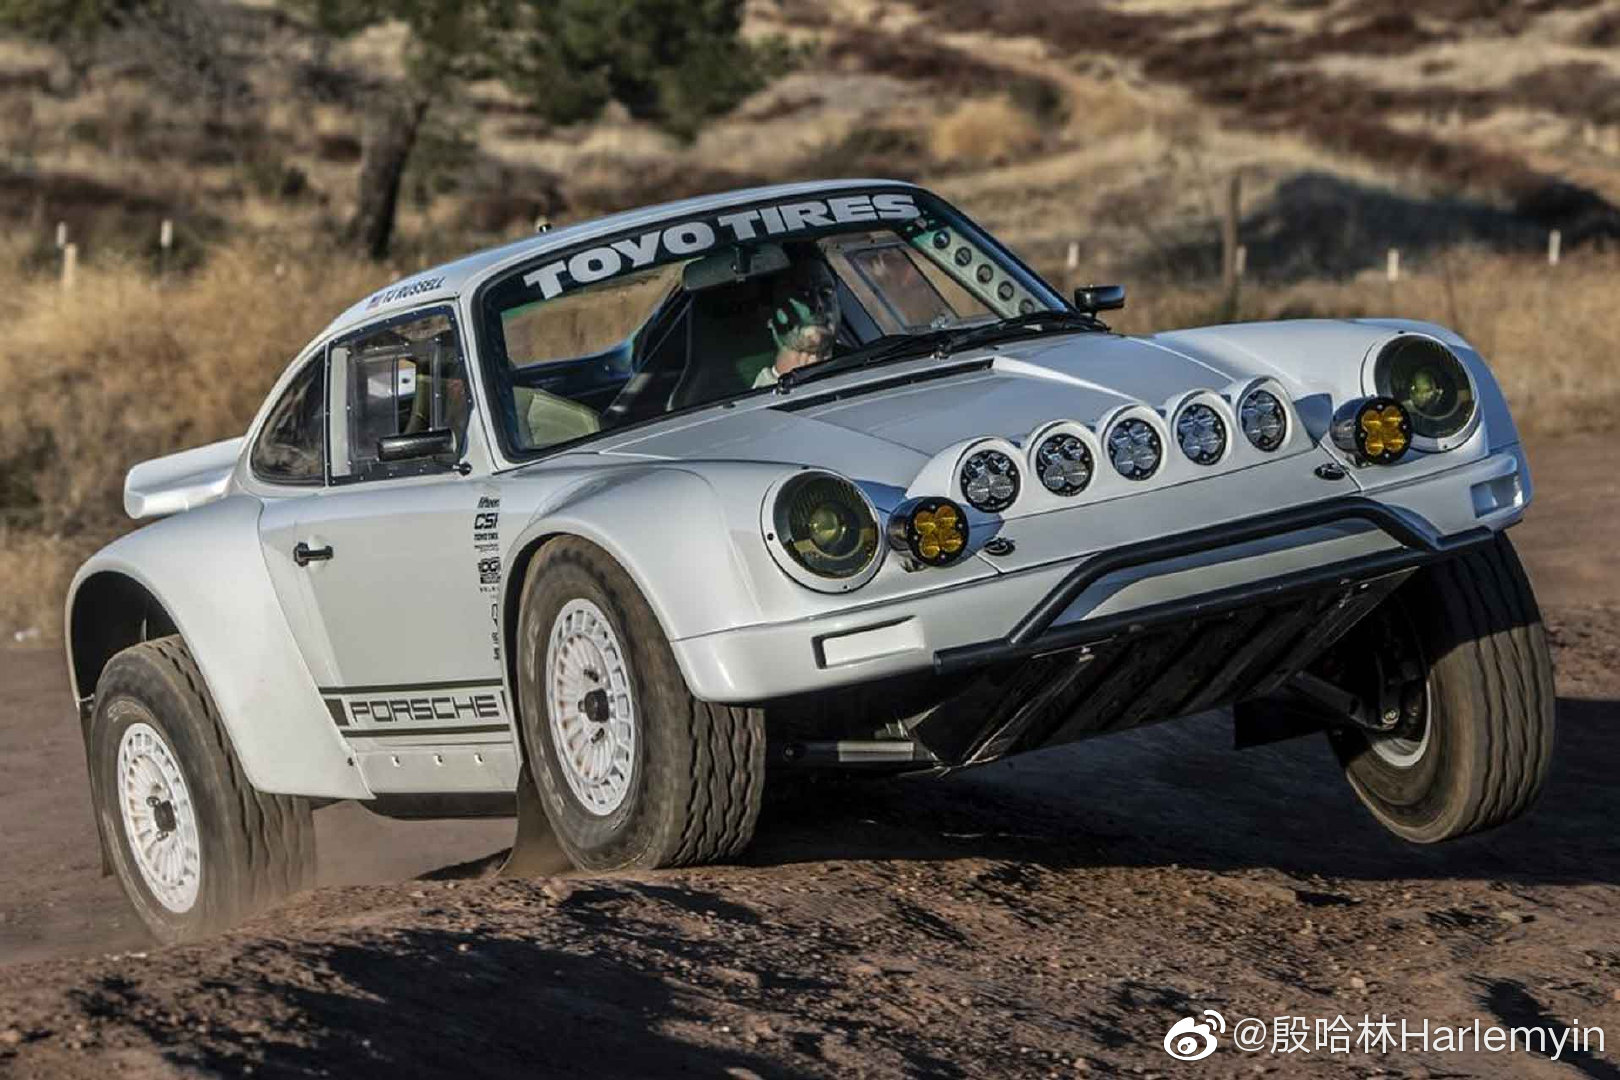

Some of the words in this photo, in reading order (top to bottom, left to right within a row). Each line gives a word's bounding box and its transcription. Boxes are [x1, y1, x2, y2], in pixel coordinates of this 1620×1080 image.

[524, 221, 715, 300] TOYO
[717, 194, 921, 240] TIRES
[350, 694, 500, 722] PORSCHE
